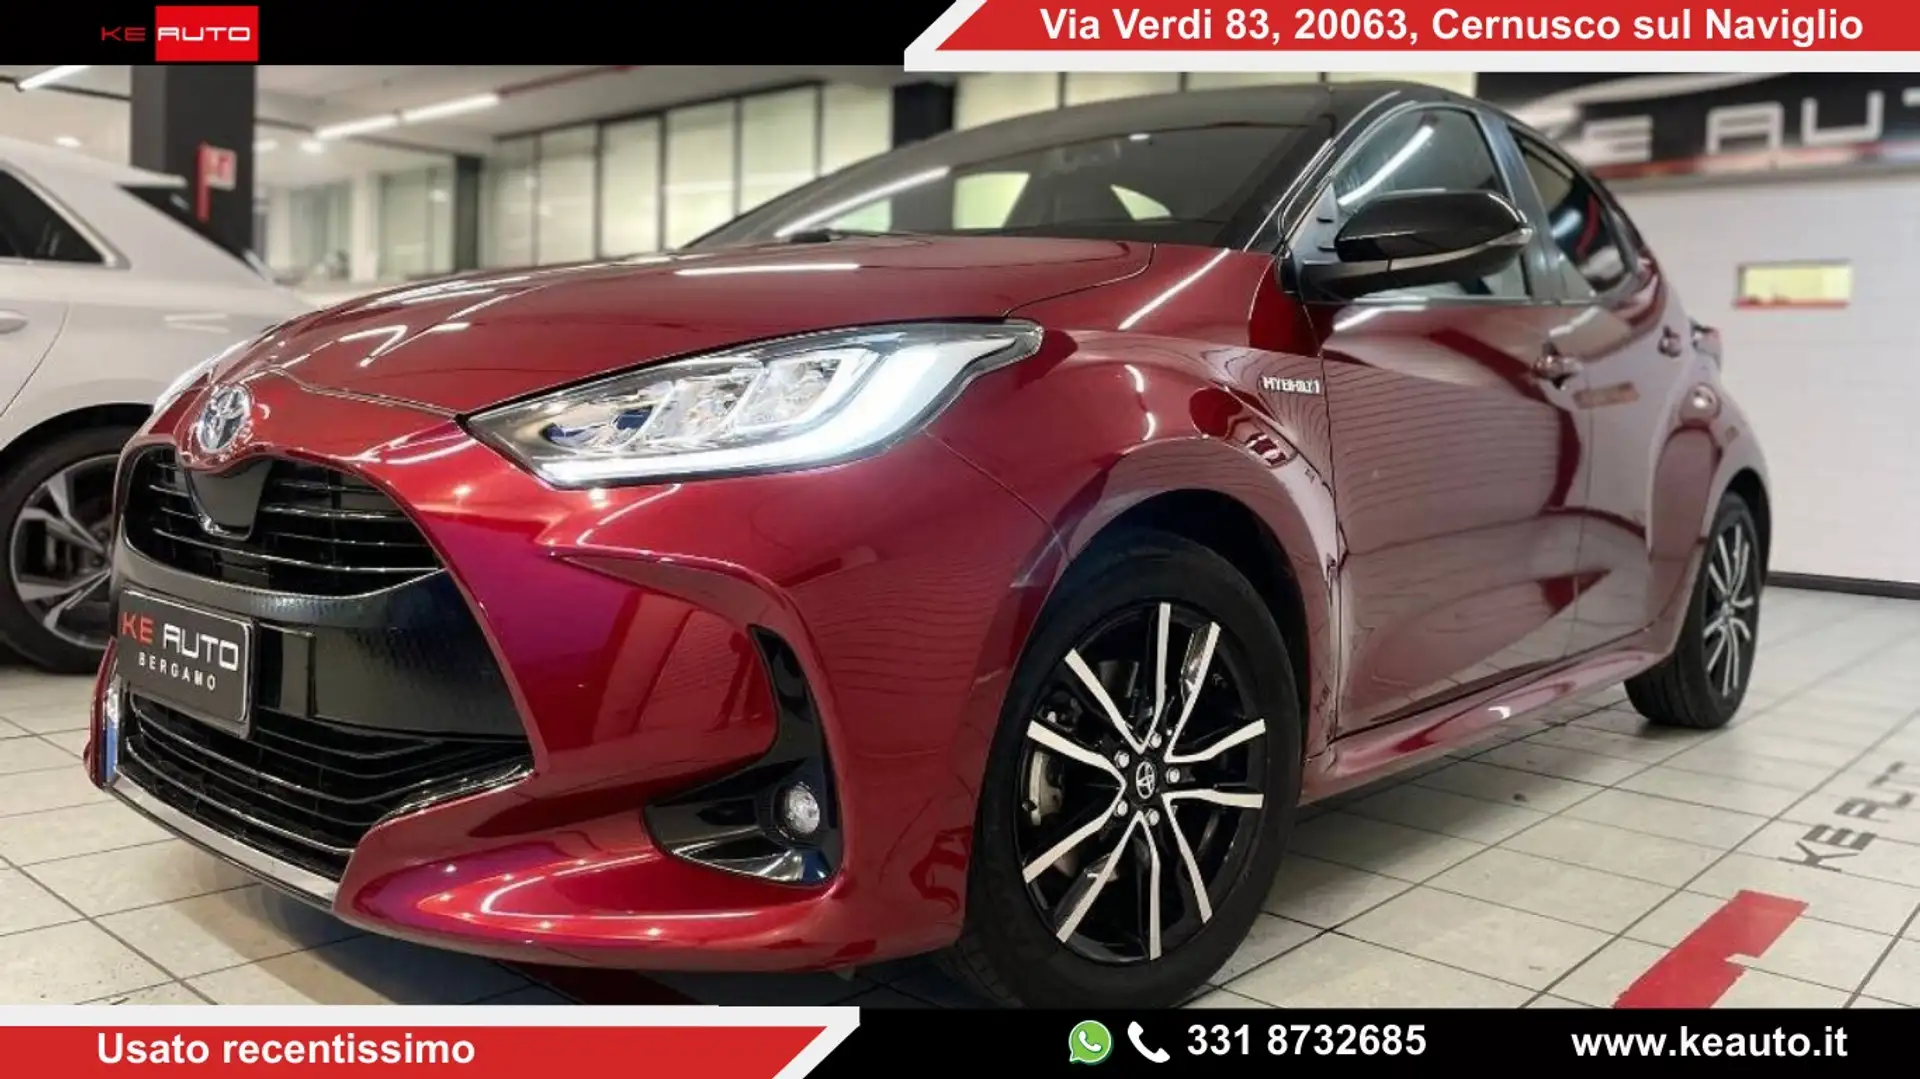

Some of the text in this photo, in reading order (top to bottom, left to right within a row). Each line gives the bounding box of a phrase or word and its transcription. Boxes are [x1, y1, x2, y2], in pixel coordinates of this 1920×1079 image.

[120, 611, 240, 672] KE AUTO
[137, 650, 217, 692] BERGAMO
